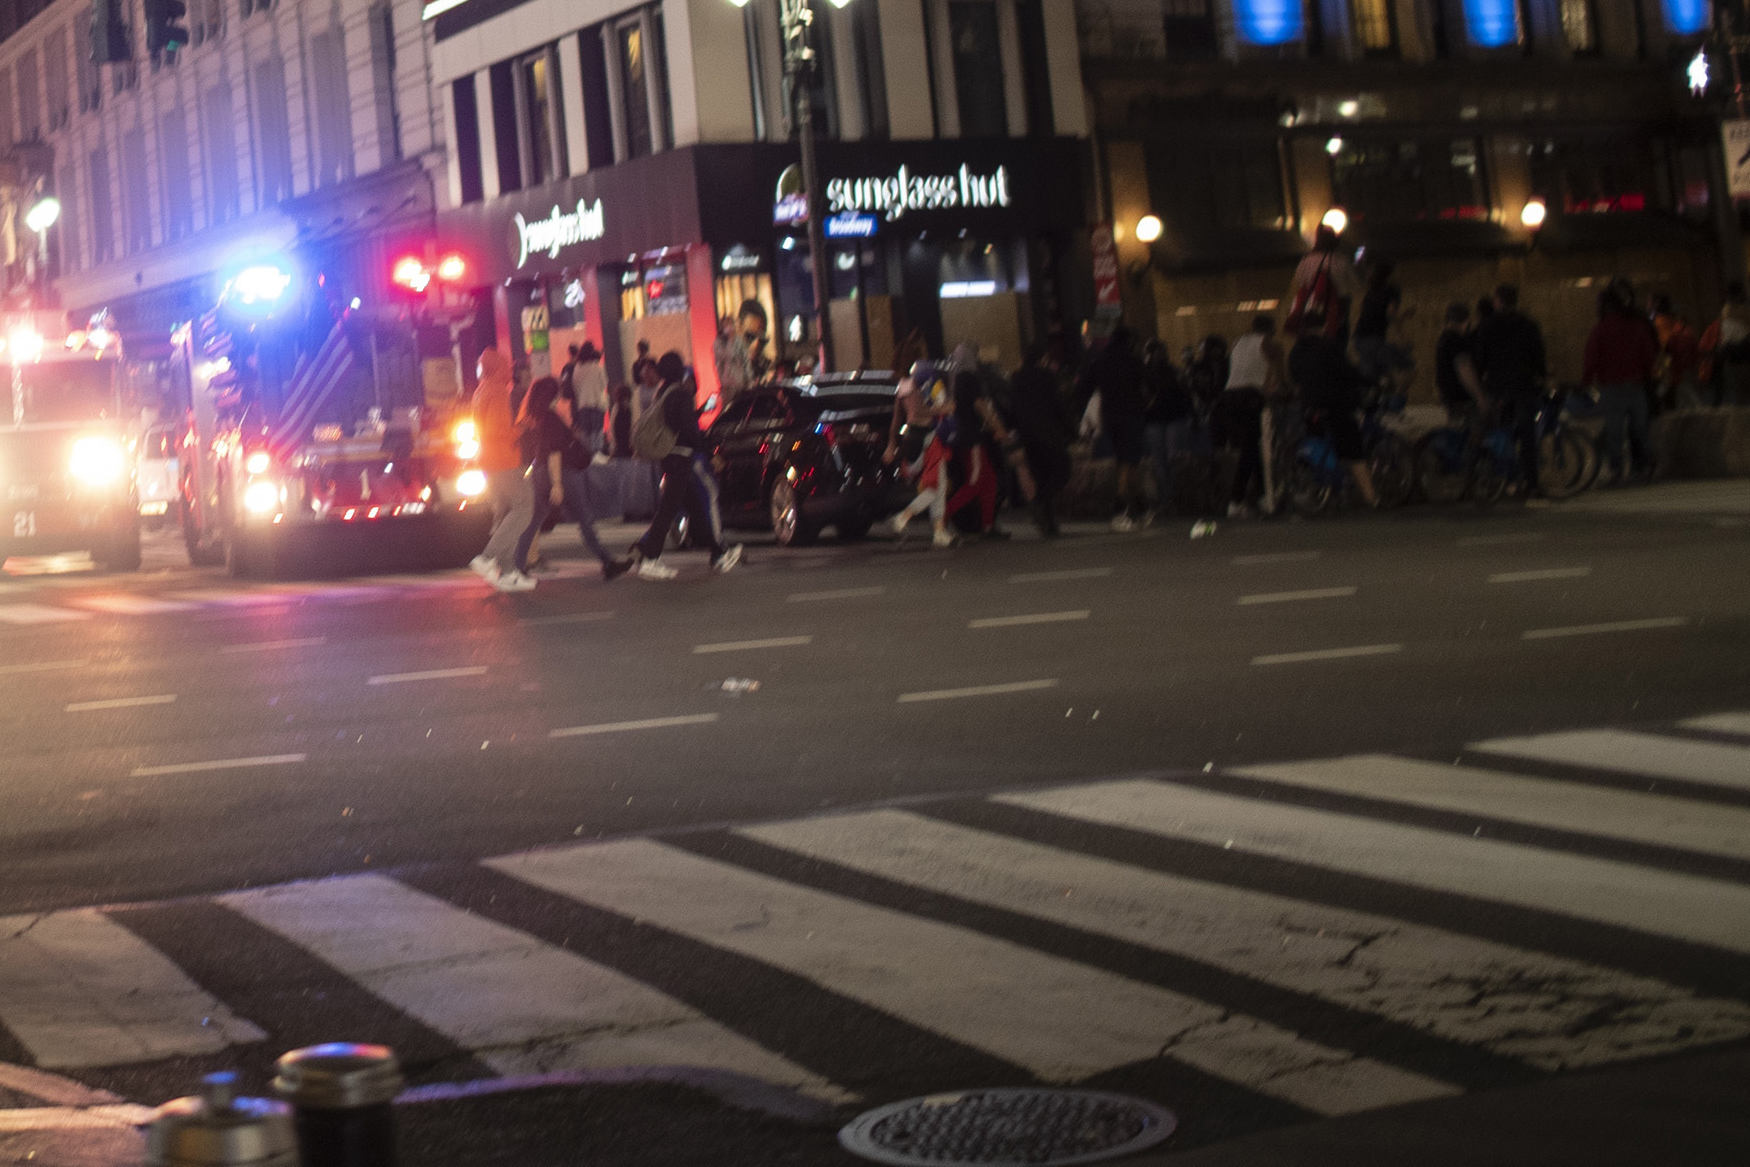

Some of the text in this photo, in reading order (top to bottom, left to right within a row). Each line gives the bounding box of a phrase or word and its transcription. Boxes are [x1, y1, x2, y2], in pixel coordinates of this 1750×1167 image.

[826, 163, 957, 222] sunglass
[959, 161, 1011, 208] hut
[12, 510, 37, 537] 21
